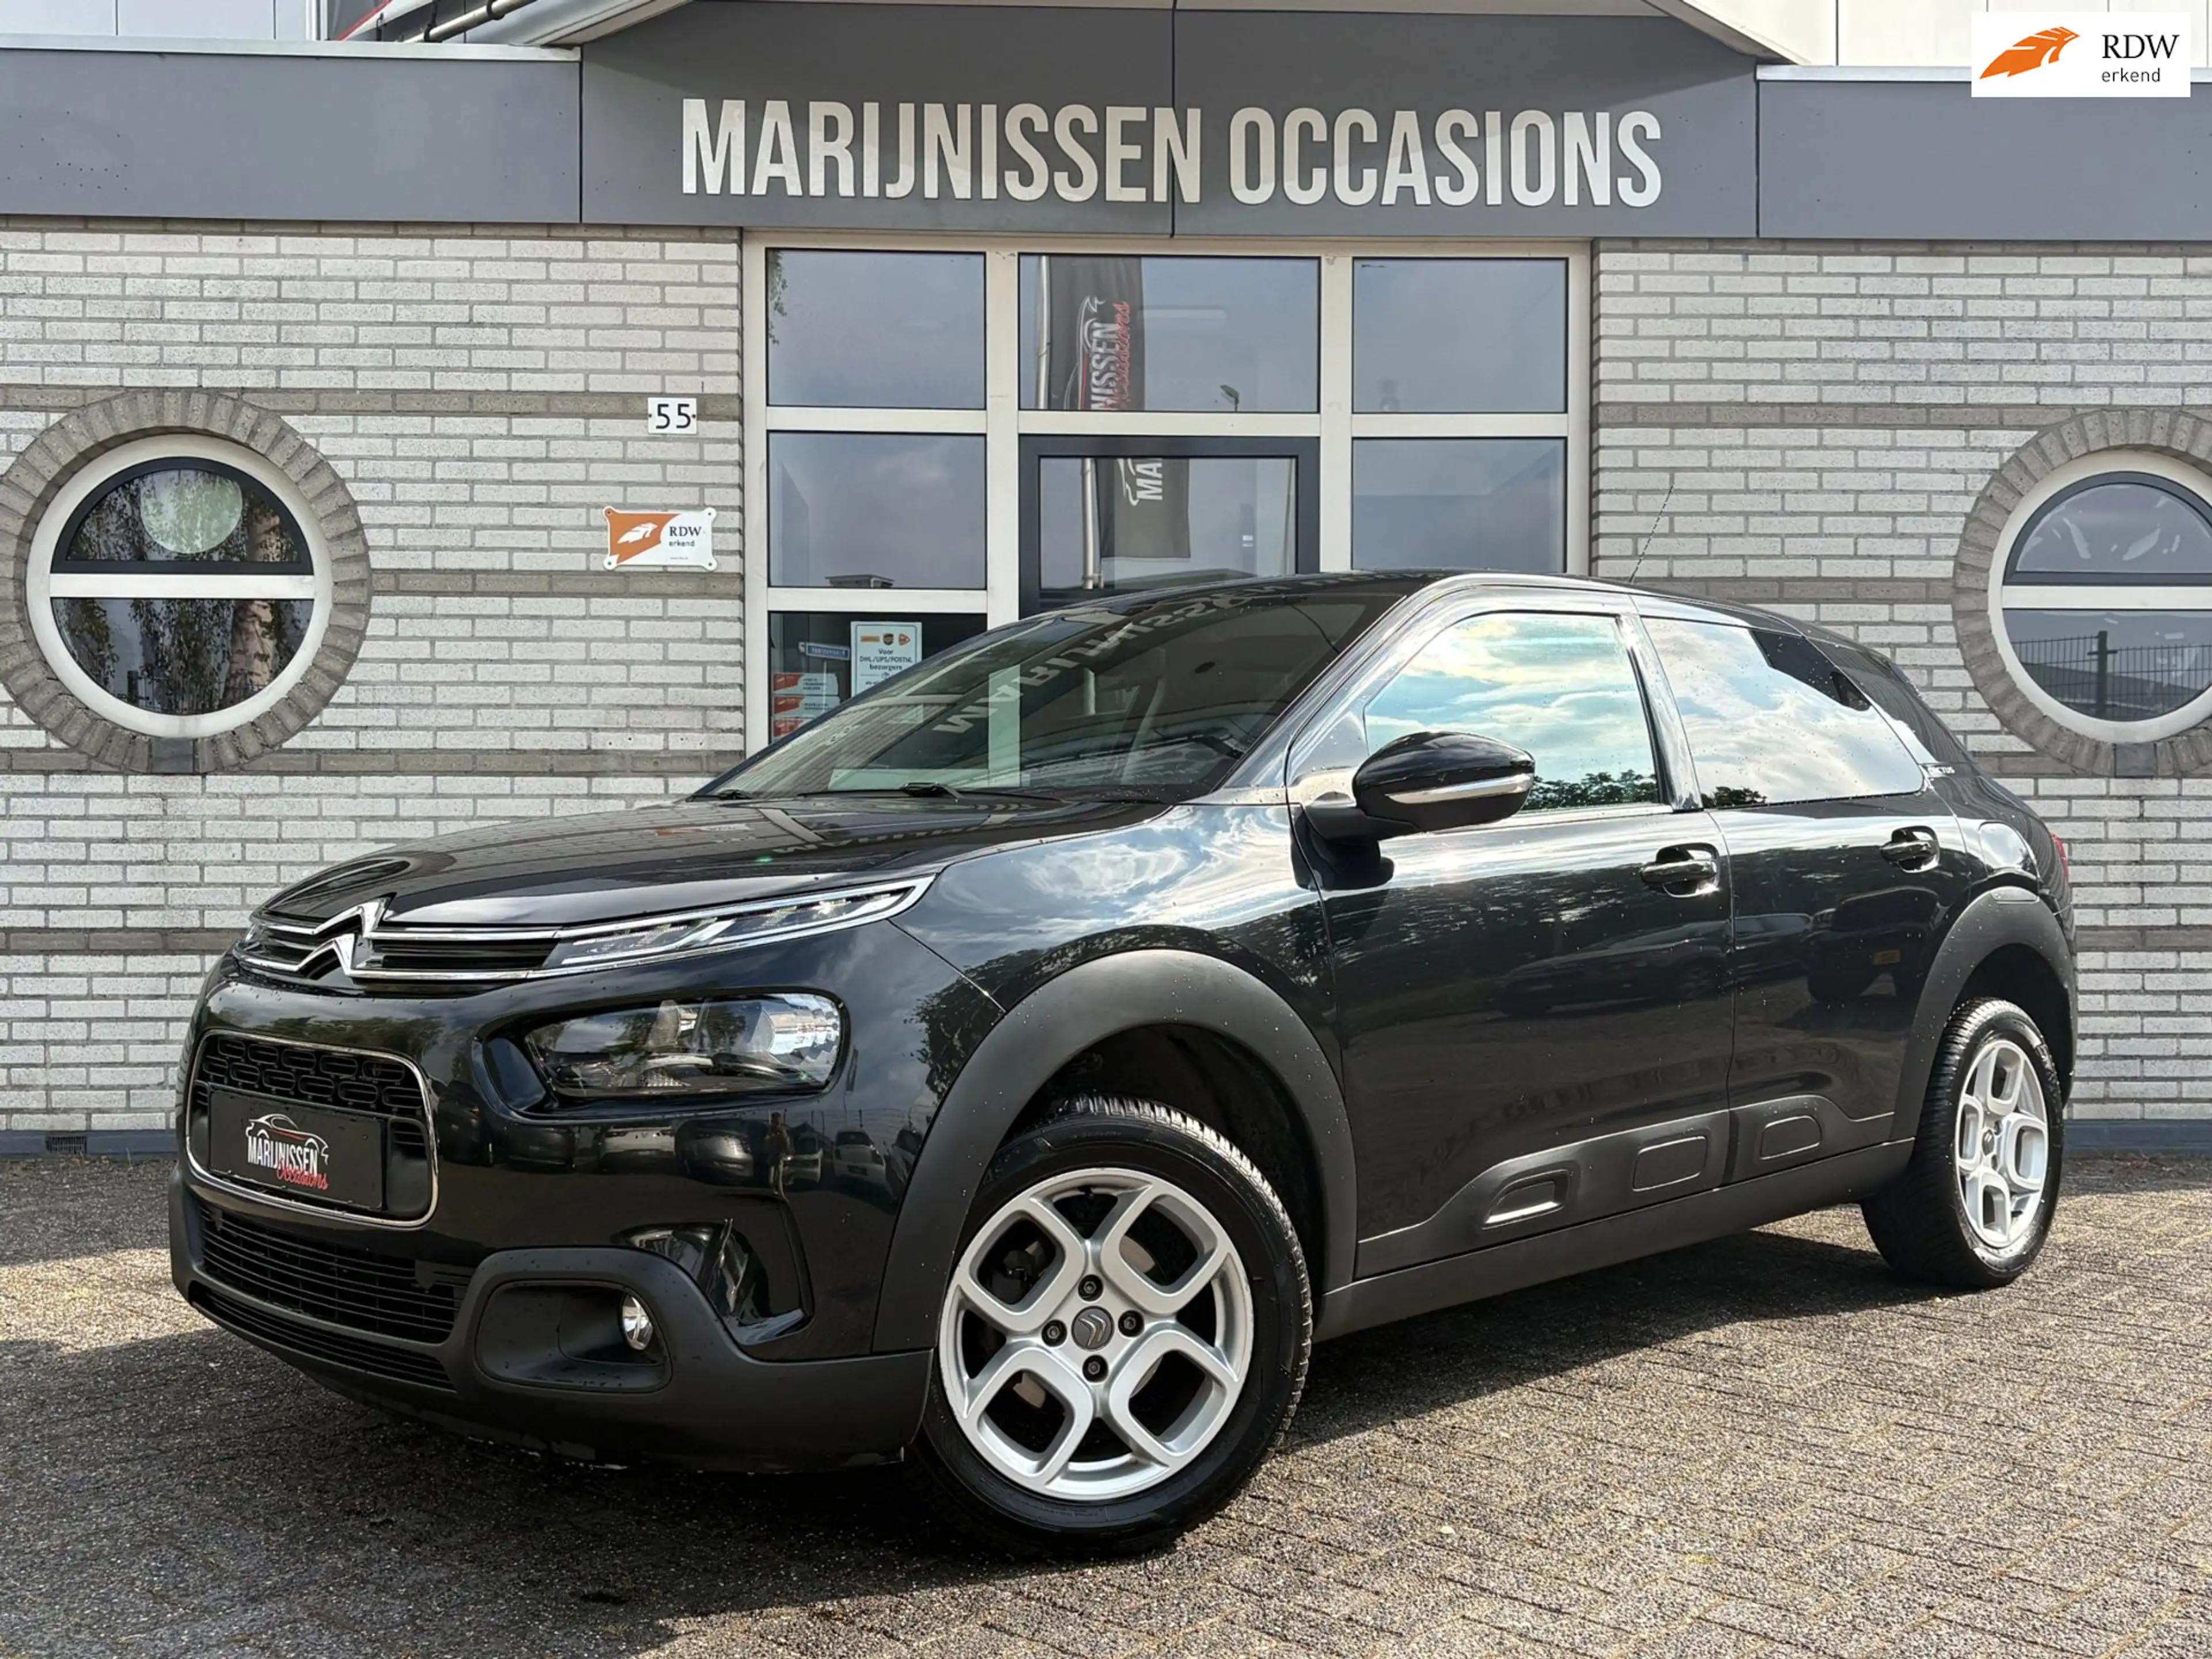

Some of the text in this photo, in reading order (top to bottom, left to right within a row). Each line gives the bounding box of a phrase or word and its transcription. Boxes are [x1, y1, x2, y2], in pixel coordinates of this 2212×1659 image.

[682, 98, 1662, 208] MARIJNISSEN OCCASIONS
[656, 404, 691, 429] 55
[1135, 458, 1163, 501] MA
[669, 525, 702, 536] RDW
[248, 1136, 319, 1176] MARIJNISSEN
